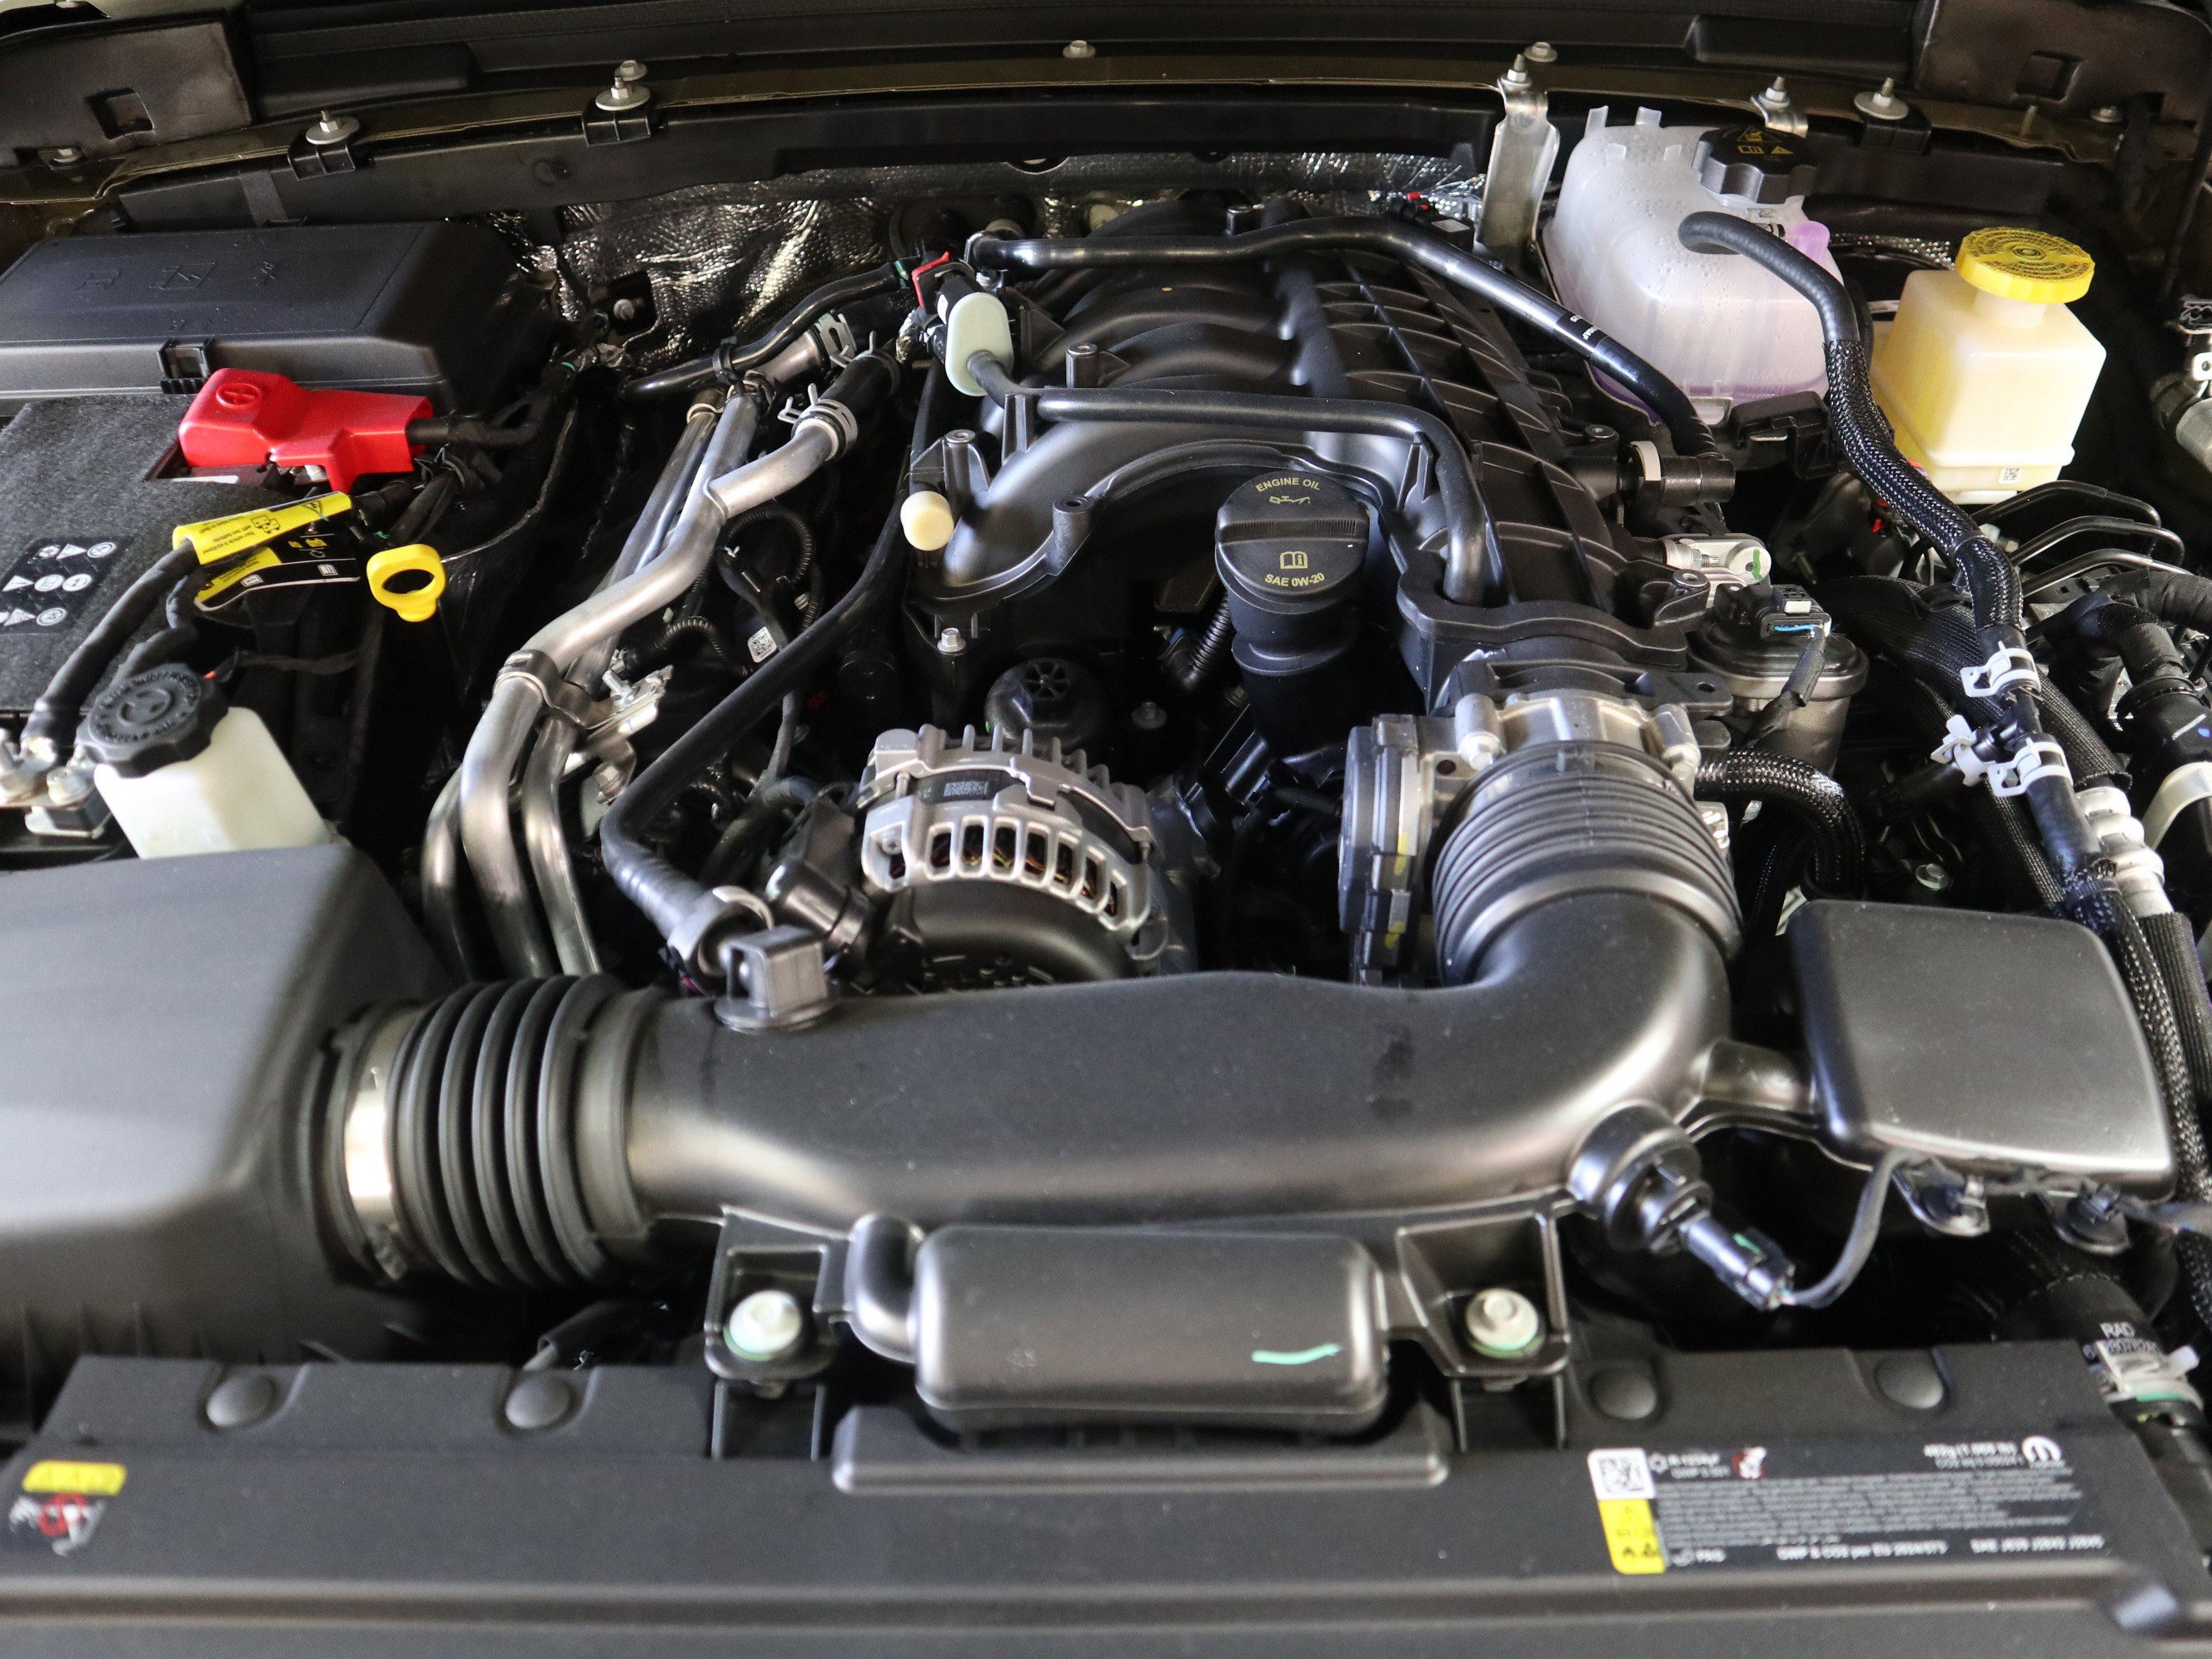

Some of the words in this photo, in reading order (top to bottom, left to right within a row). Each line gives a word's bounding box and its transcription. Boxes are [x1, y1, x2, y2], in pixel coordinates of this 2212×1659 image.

[1255, 477, 1299, 492] ENGINE
[1303, 479, 1321, 491] OIL
[1265, 574, 1289, 587] SAE
[1291, 572, 1325, 587] 0W-20
